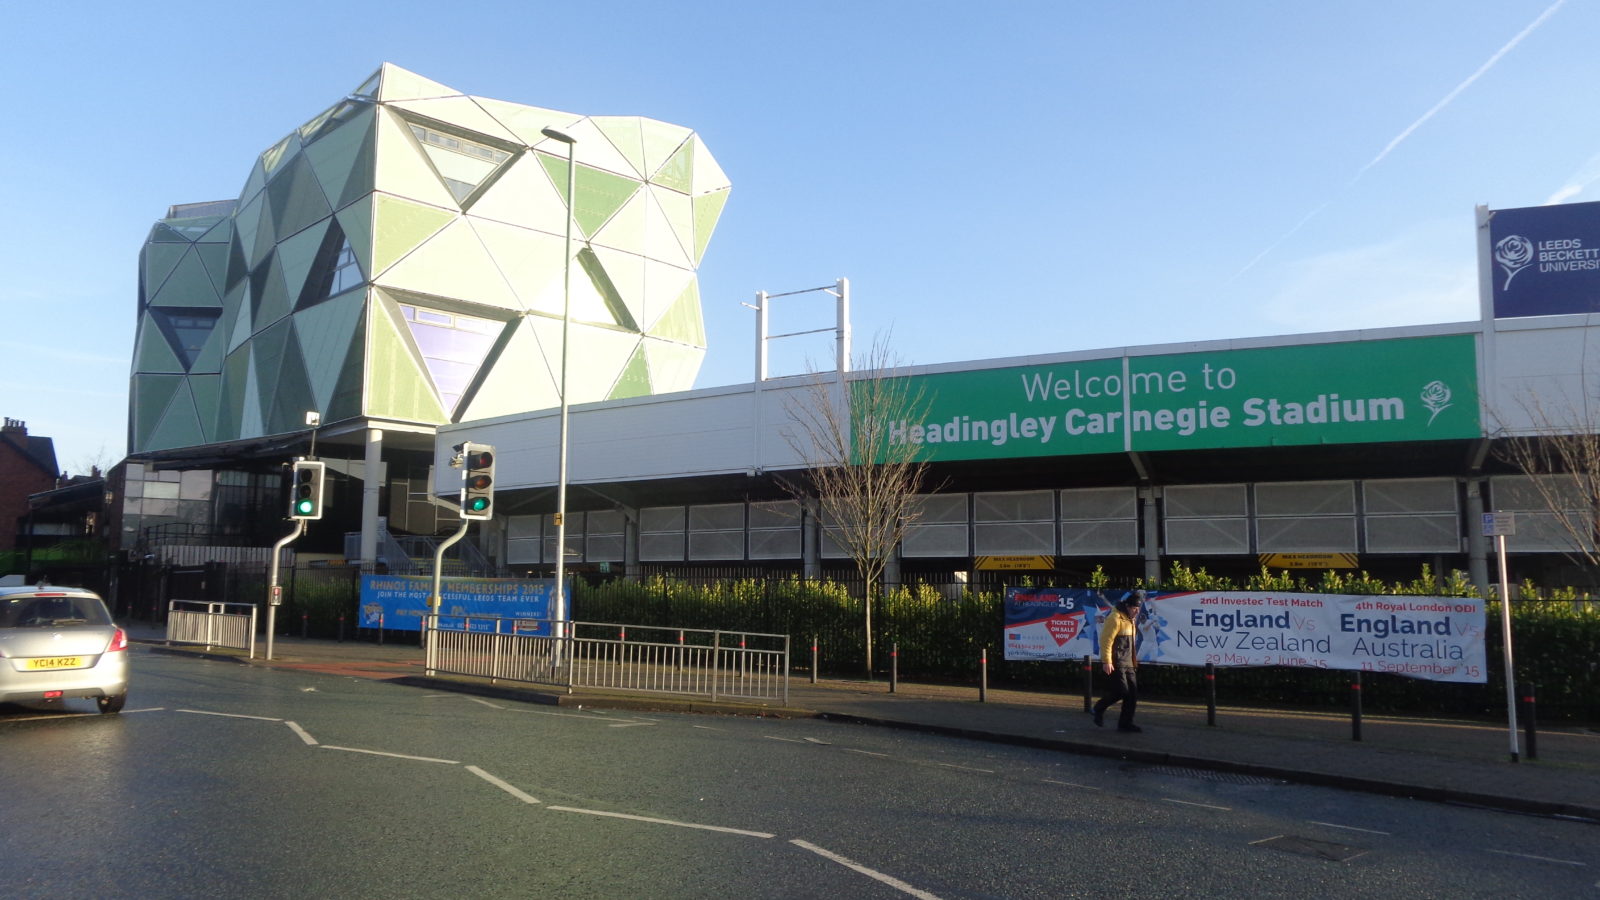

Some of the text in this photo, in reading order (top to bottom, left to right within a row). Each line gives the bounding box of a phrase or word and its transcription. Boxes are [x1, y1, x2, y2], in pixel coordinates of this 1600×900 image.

[1538, 239, 1582, 250] LEEDS
[1539, 248, 1599, 262] BECKETT
[1540, 260, 1600, 272] UNIVERSI
[1021, 363, 1236, 402] Welcome to
[889, 393, 1405, 446] Headingley Carnegie Stadium
[370, 581, 545, 595] RHINOS FAMIY MEMBERSHIPS 2015
[377, 591, 392, 599] JOIN
[395, 591, 407, 599] THE
[428, 592, 471, 601] SCESSFUL
[474, 594, 494, 602] LEEDS
[1200, 597, 1323, 608] 2nd Investec Test Match
[1355, 602, 1476, 615] 4th Royal London ODI
[1190, 609, 1291, 632] England
[1340, 613, 1452, 638] England
[1177, 630, 1331, 654] New Zealand
[1352, 637, 1464, 660] Australia
[33, 657, 77, 668] YC14 KZZ
[1206, 653, 1221, 665] 29
[1224, 653, 1250, 666] May
[1263, 655, 1271, 665] 2
[1276, 655, 1307, 666] June
[1361, 661, 1374, 672] 11
[1377, 660, 1457, 675] September
